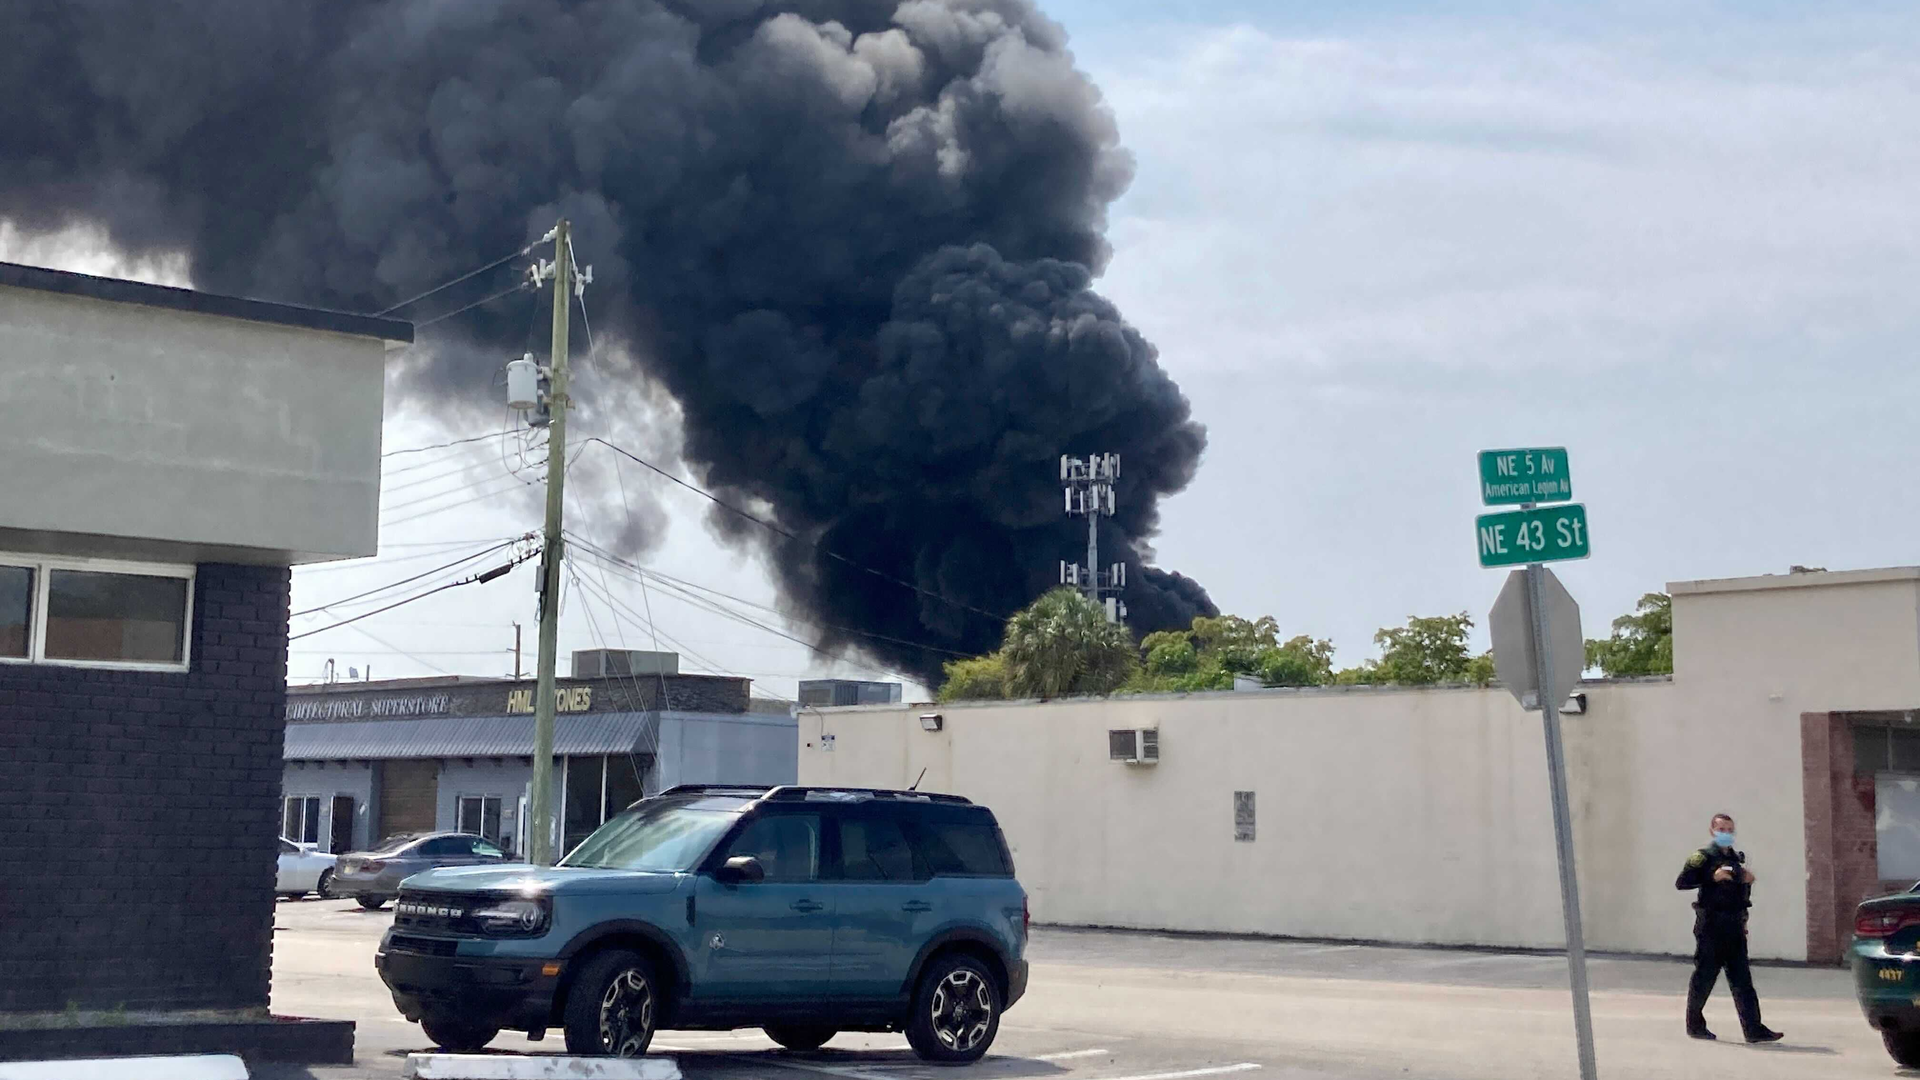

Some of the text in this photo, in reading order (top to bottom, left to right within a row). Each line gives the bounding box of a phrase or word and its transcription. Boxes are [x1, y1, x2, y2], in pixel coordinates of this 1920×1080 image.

[1497, 455, 1518, 476] NE
[1525, 454, 1535, 475] 5
[1485, 481, 1530, 498] American
[1532, 479, 1558, 499] Legion
[1480, 517, 1583, 556] NE 43 St
[371, 694, 448, 716] SUPERSTORE
[507, 689, 535, 714] HML
[399, 903, 463, 918] BRONCO
